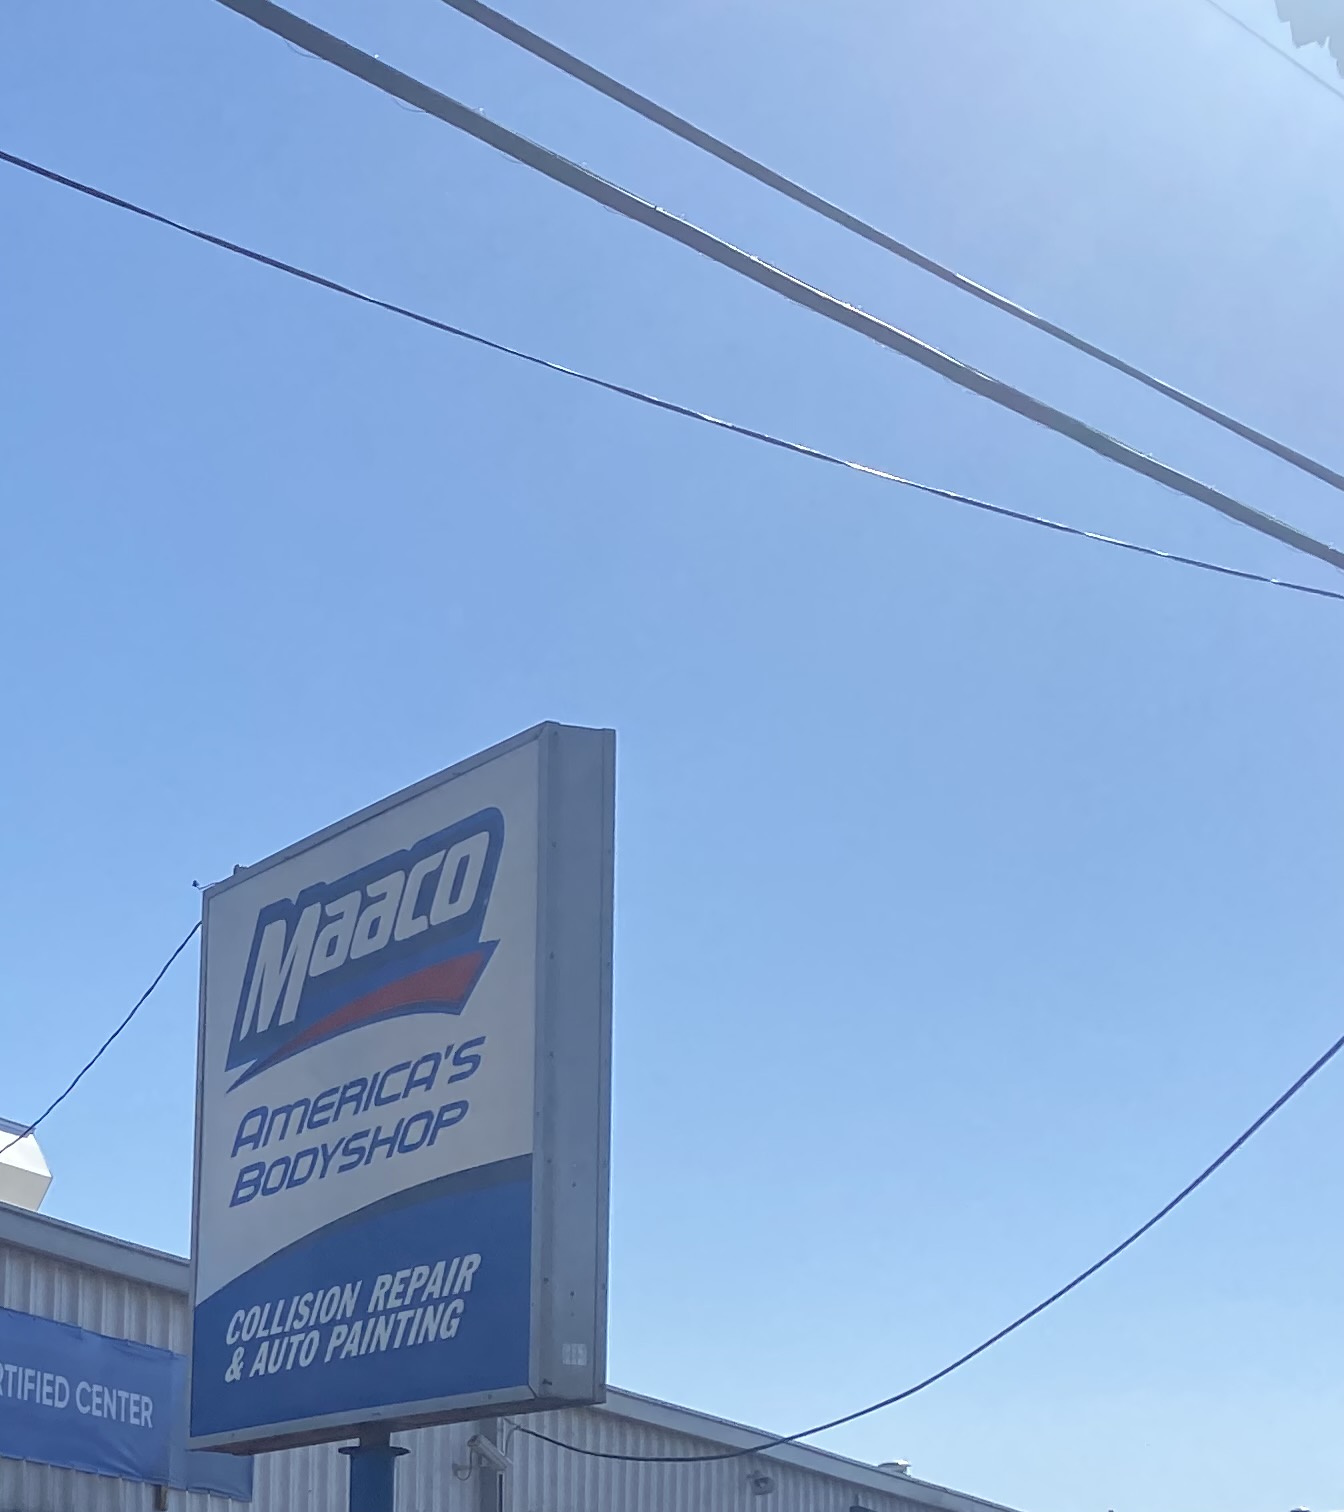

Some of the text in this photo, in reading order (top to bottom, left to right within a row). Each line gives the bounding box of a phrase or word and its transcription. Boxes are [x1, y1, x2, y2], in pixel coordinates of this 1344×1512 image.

[239, 830, 490, 1043] Maaco
[230, 1035, 487, 1158] AMERICA'S
[229, 1099, 470, 1208] BODYSHOP
[224, 1252, 482, 1345] COLLISION REPAIR
[224, 1298, 465, 1383] & AUTO PAINTING
[75, 1380, 154, 1429] CENTER
